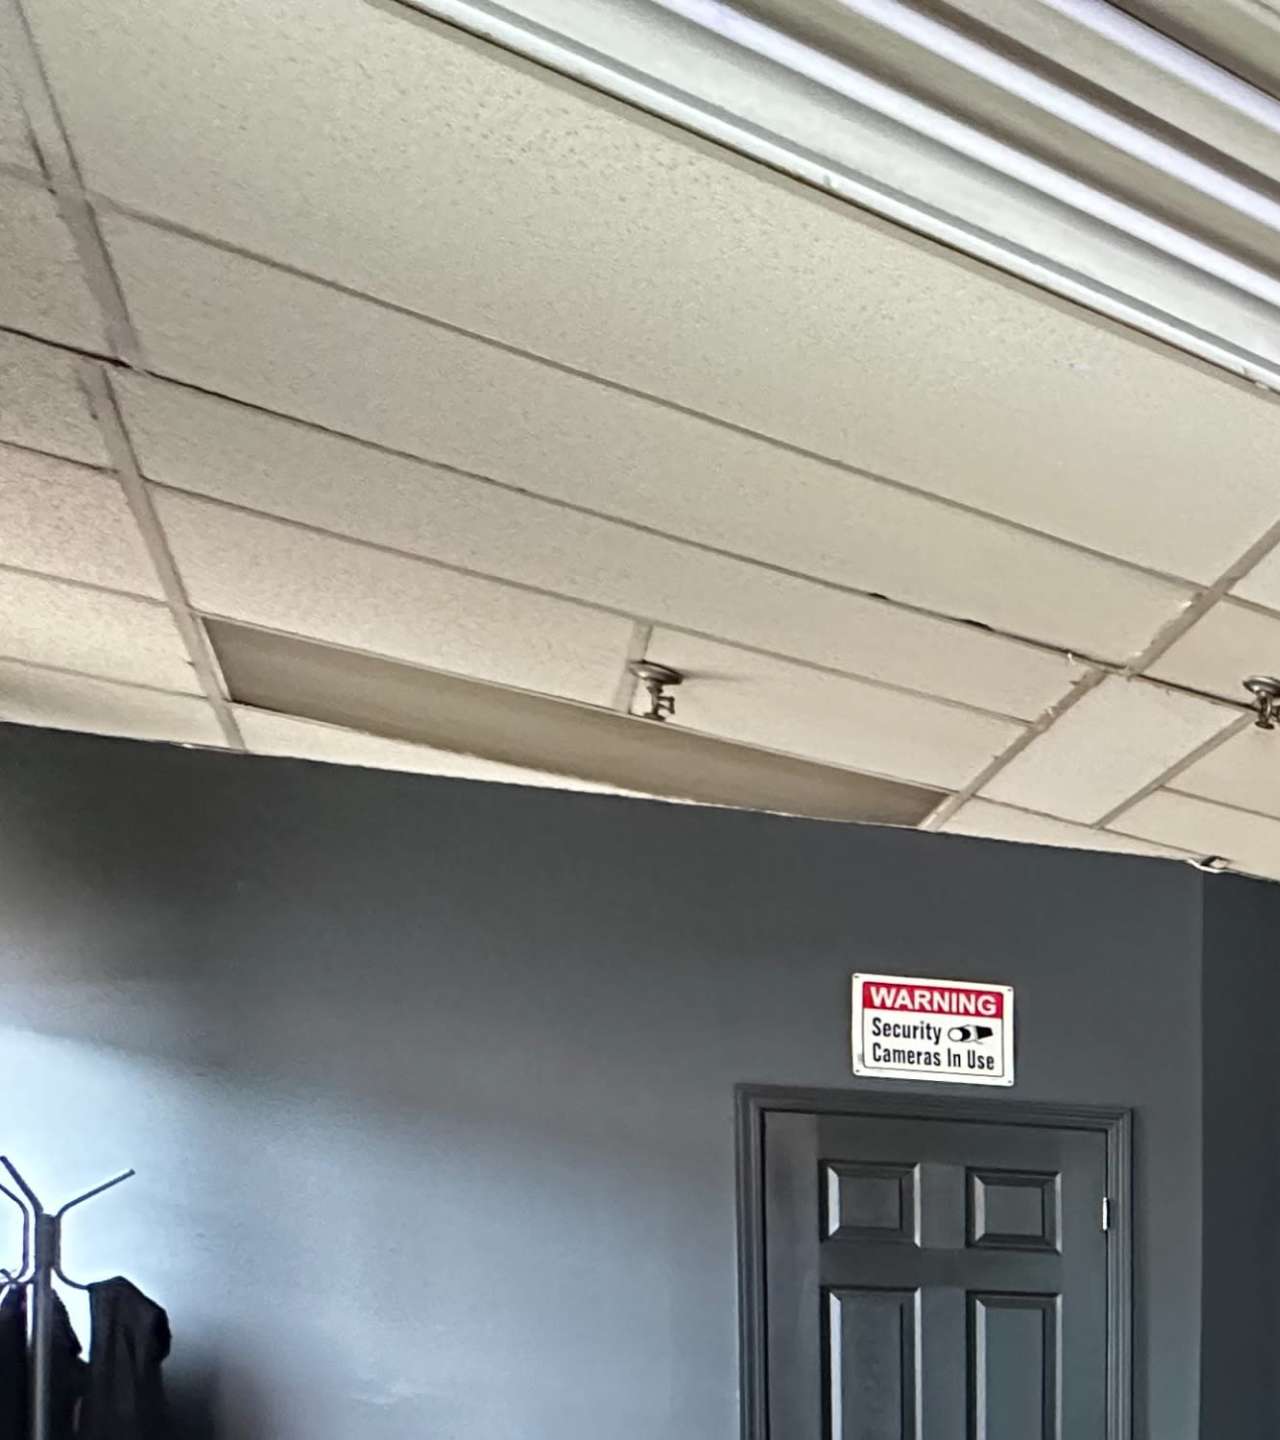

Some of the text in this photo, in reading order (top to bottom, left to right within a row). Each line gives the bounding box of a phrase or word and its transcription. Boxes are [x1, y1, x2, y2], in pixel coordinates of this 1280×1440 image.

[870, 986, 996, 1015] WARNING
[872, 1017, 941, 1044] Security
[872, 1042, 995, 1070] Cameras In Use
